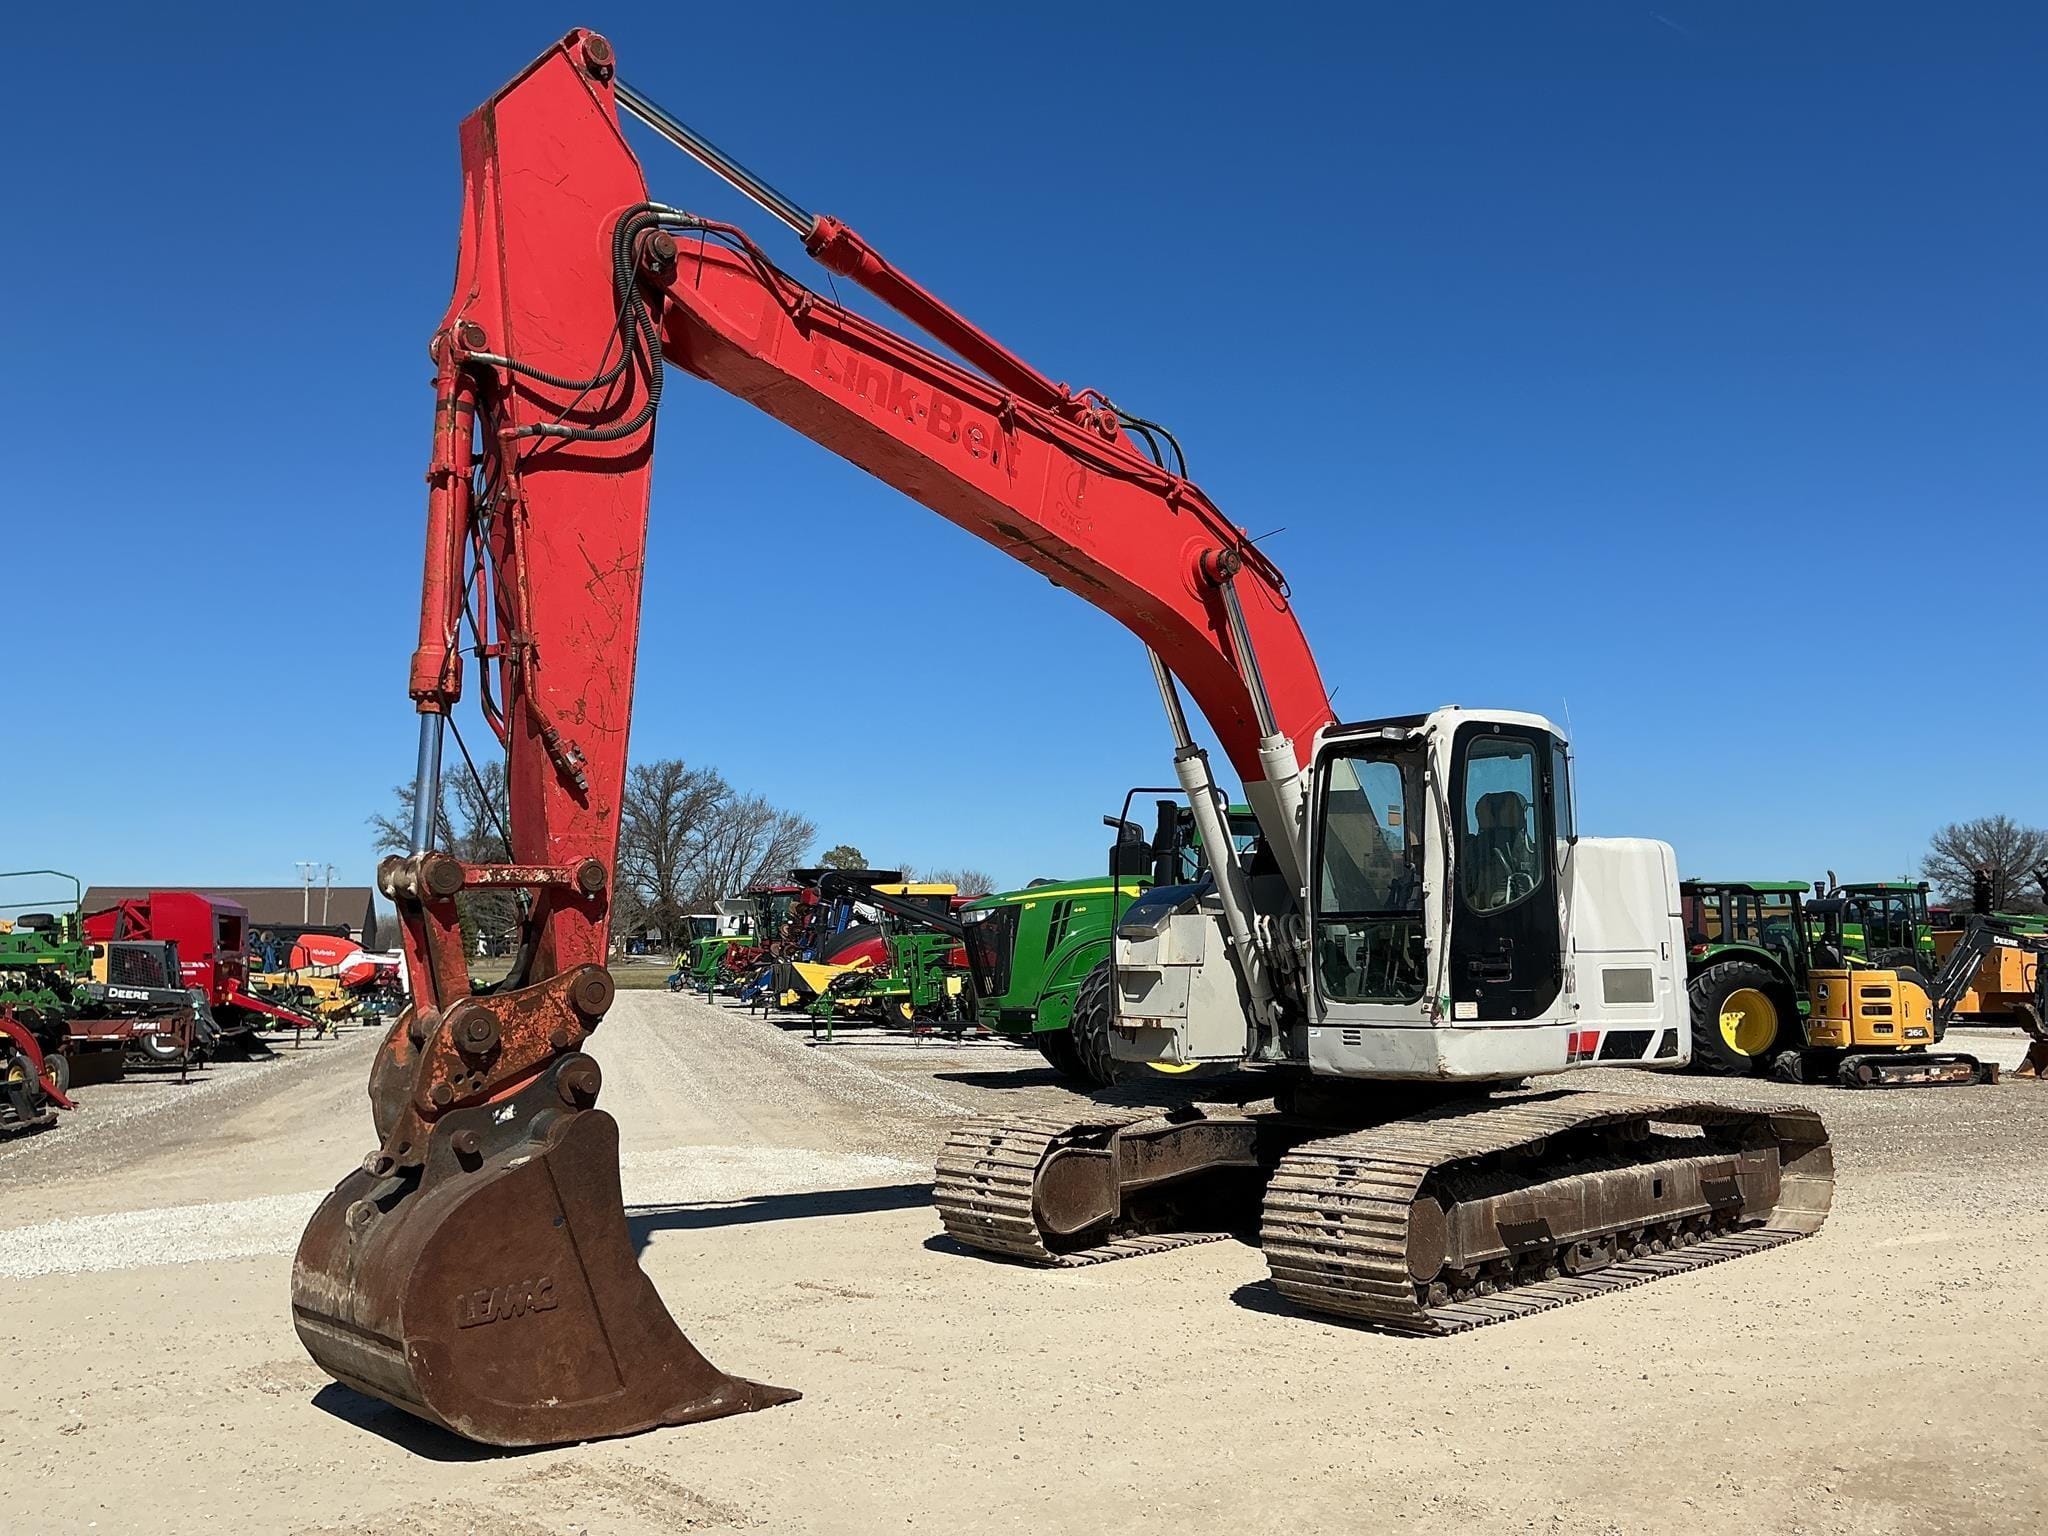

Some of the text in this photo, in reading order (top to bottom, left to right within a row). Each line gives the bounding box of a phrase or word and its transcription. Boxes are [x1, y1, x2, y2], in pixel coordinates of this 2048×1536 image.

[1993, 935, 2018, 947] DEERE
[108, 987, 150, 1000] DEERE
[456, 1276, 559, 1330] LEMAC
